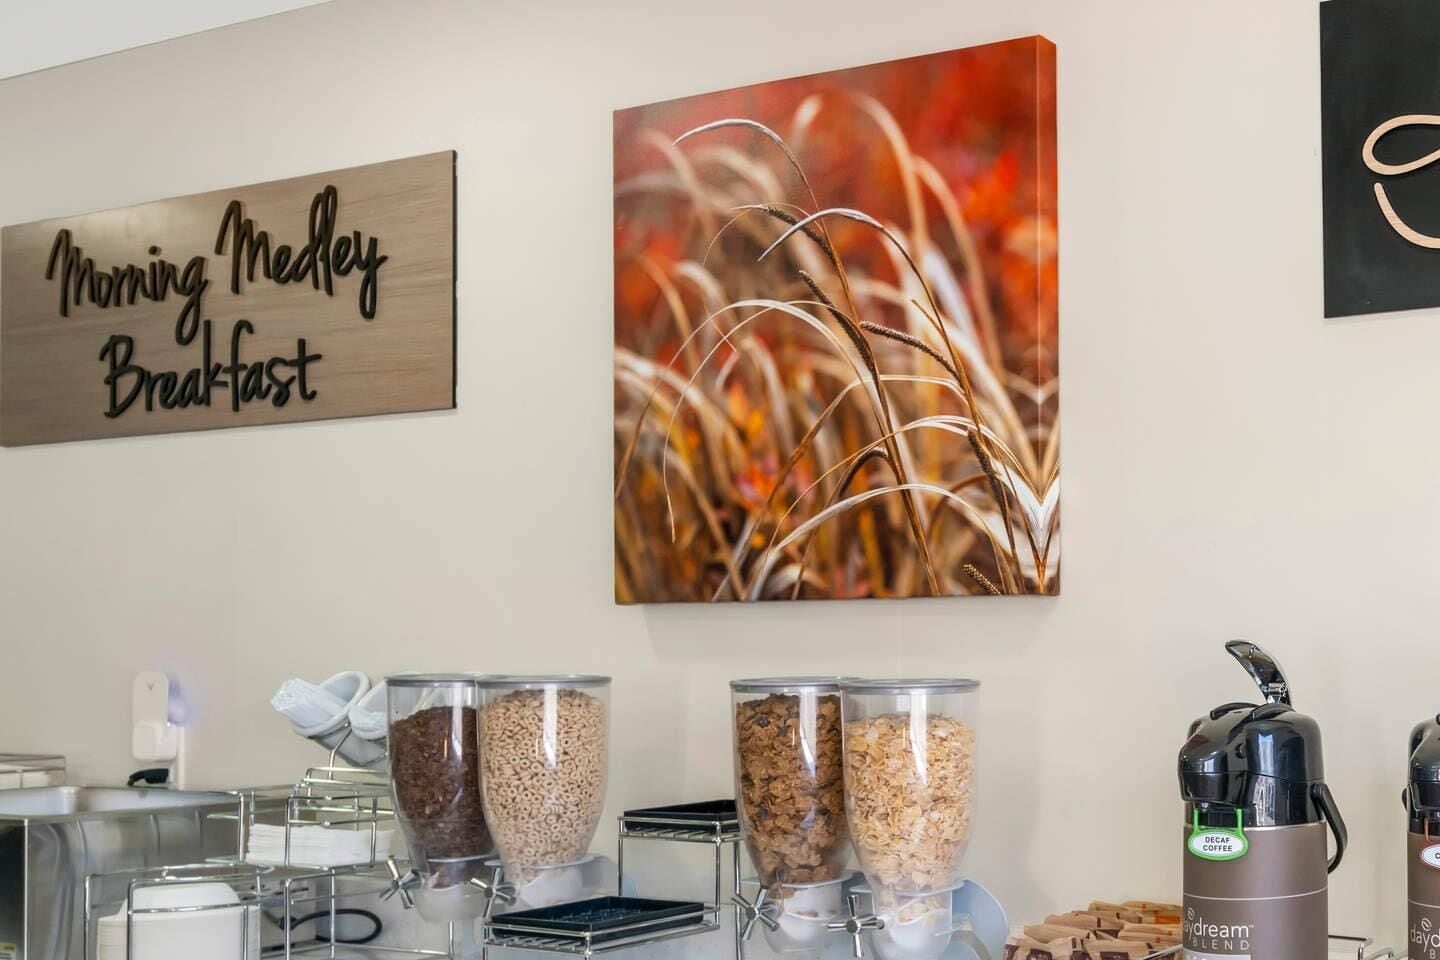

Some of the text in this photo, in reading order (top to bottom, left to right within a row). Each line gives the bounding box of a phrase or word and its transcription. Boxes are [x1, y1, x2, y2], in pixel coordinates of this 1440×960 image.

[45, 185, 388, 346] Morning Medley
[99, 319, 322, 419] Breakfast
[1204, 836, 1230, 844] DECAF
[1203, 844, 1232, 852] COFFEE
[1192, 937, 1249, 950] BLEND
